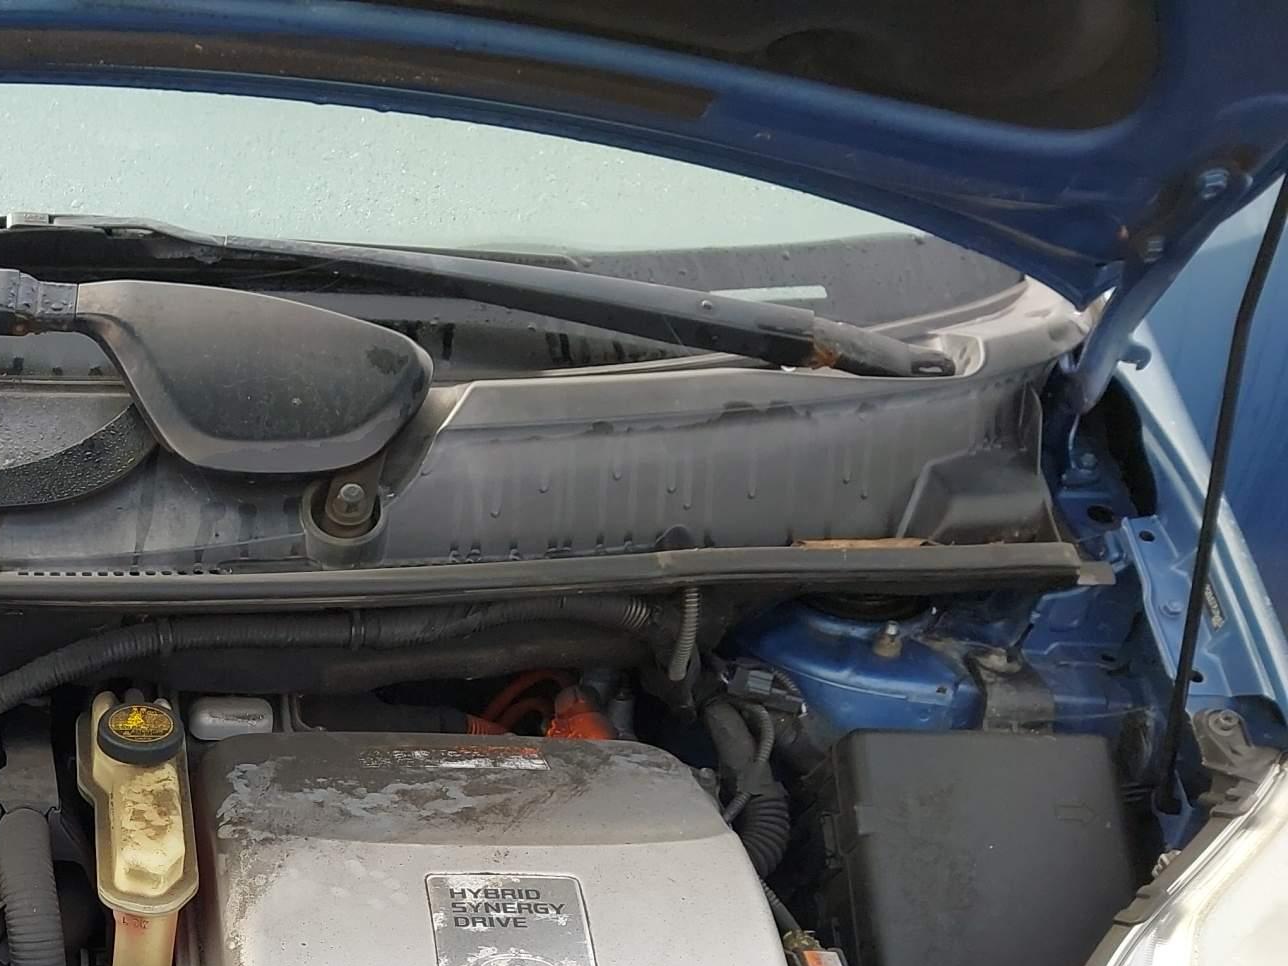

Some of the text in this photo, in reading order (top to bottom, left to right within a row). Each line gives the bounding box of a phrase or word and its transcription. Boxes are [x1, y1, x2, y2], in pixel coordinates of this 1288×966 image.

[448, 887, 541, 900] HYBRID
[451, 901, 566, 915] SYNERGY
[453, 916, 528, 928] DRIVE
